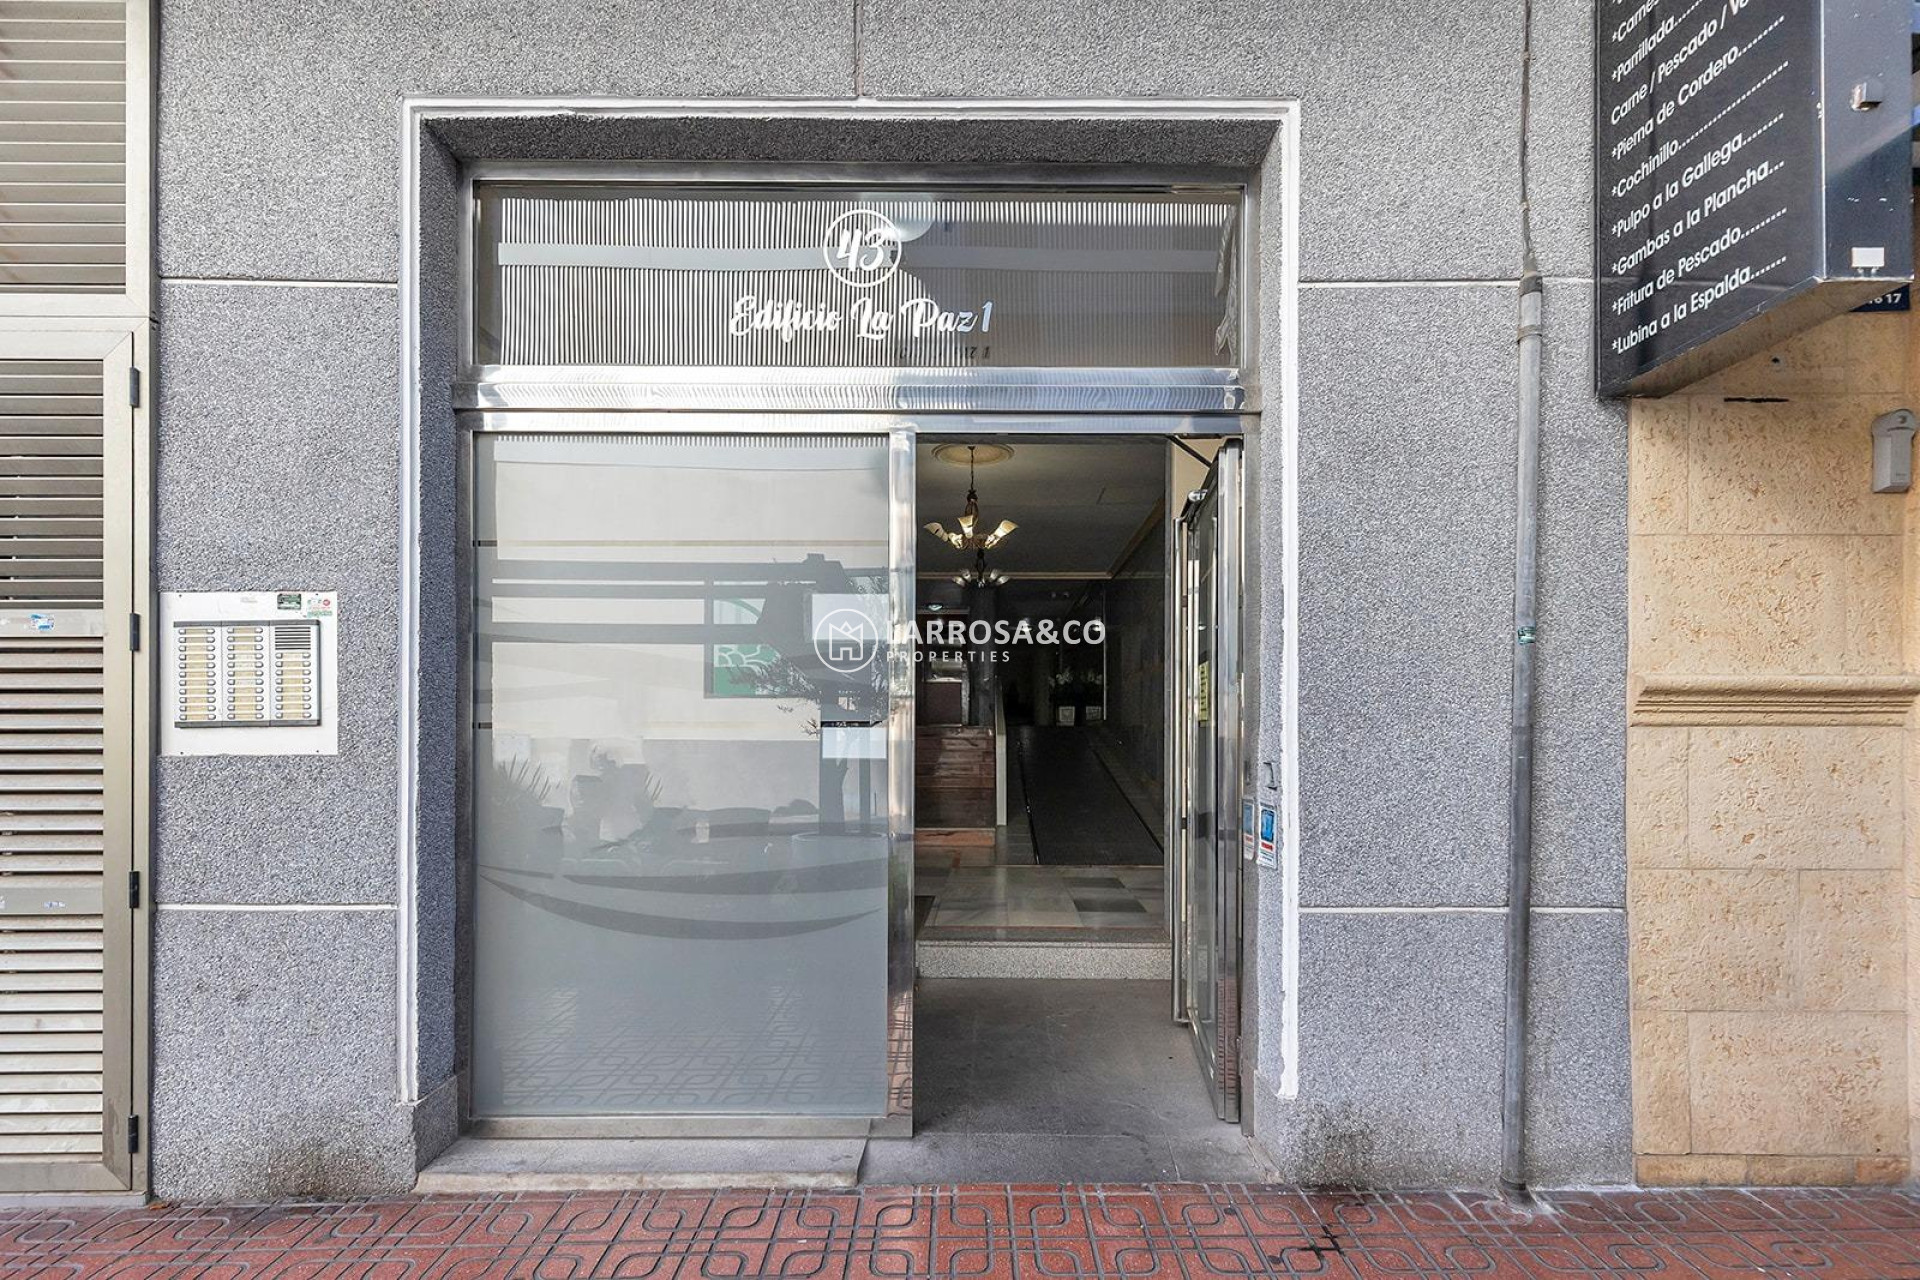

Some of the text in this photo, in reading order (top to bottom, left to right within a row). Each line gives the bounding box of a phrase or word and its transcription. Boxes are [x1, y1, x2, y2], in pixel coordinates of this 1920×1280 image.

[1611, 83, 1648, 125] Carne
[1658, 18, 1717, 84] Pescado
[1656, 100, 1675, 125] de
[1653, 192, 1662, 210] a
[1665, 180, 1679, 202] la
[1673, 219, 1683, 237] a
[1686, 207, 1700, 229] la
[836, 227, 888, 271] 43
[1656, 268, 1675, 290] de
[1886, 293, 1902, 304] 17
[730, 295, 842, 342] Edificio
[851, 297, 894, 340] La
[900, 298, 978, 337] Paz
[1660, 312, 1670, 329] a
[1673, 302, 1687, 323] la
